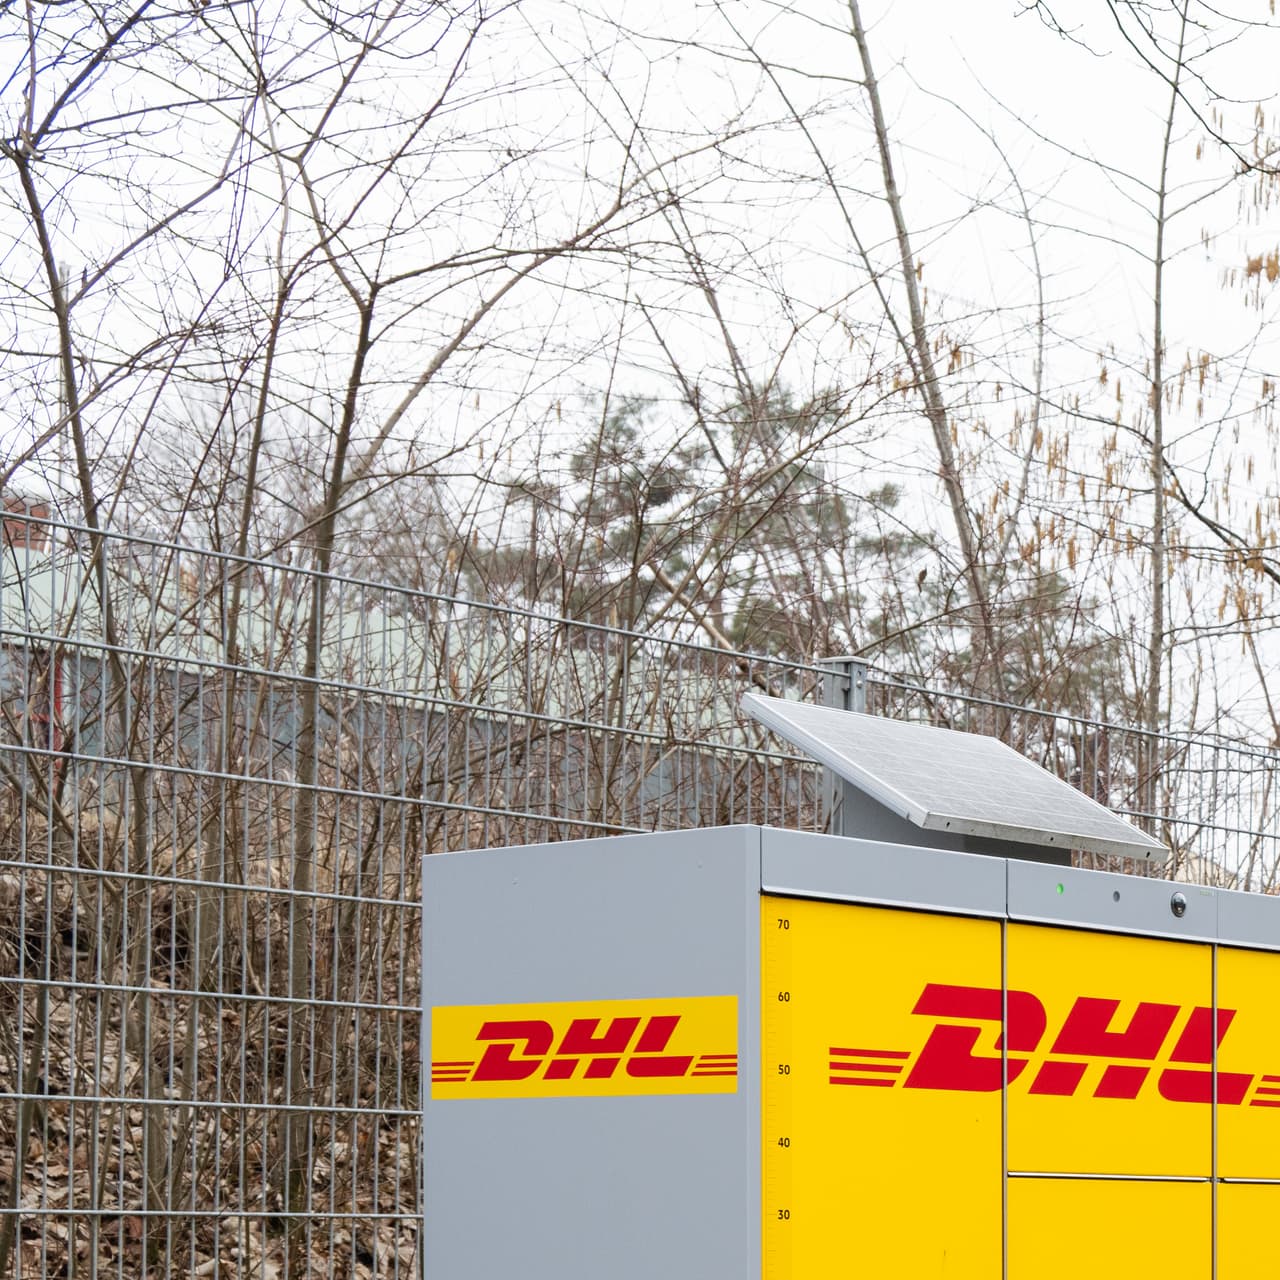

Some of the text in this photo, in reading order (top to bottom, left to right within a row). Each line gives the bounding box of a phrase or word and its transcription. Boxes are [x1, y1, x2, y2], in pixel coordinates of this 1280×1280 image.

[777, 918, 790, 931] 70
[777, 991, 790, 1003] 60
[471, 1015, 695, 1082] DHL
[903, 982, 1255, 1106] DHL
[777, 1064, 790, 1075] 50
[777, 1137, 790, 1149] 40
[777, 1209, 790, 1221] 30
